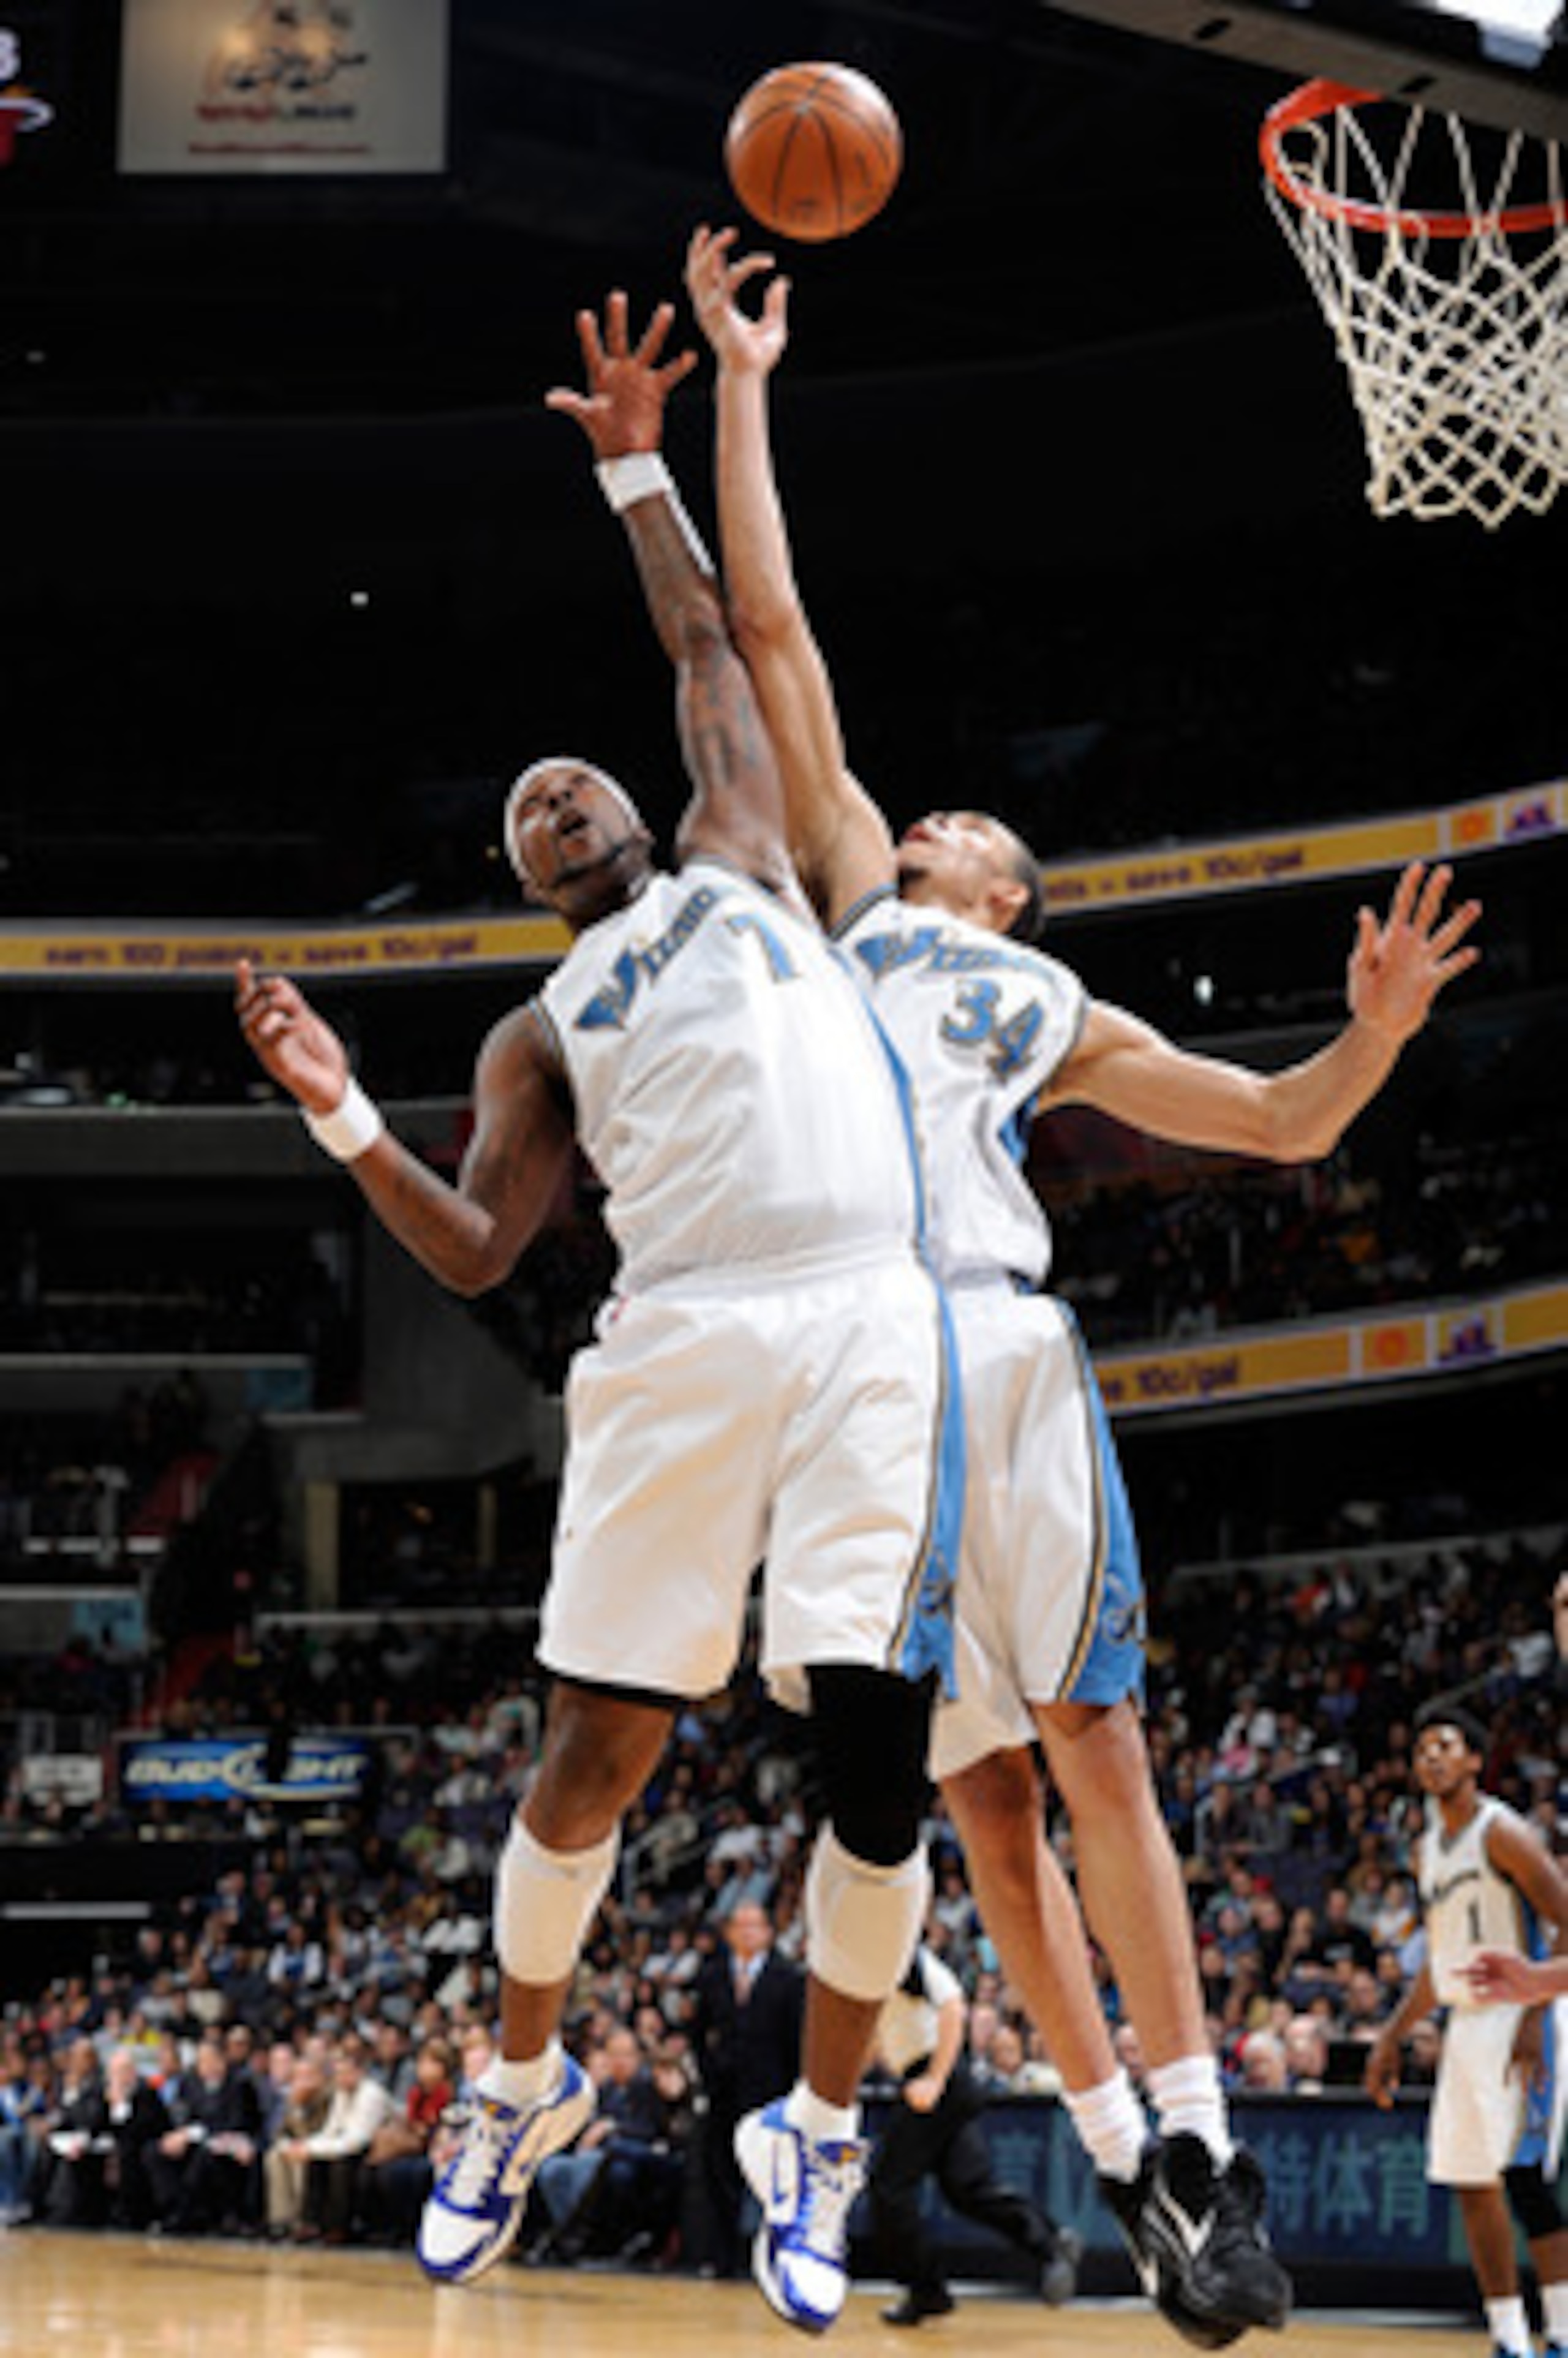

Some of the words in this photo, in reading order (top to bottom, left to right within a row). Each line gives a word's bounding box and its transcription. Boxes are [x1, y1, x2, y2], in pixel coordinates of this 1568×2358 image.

[725, 913, 801, 984] 7
[940, 979, 1045, 1084] 34
[1468, 1900, 1481, 1944] 1
